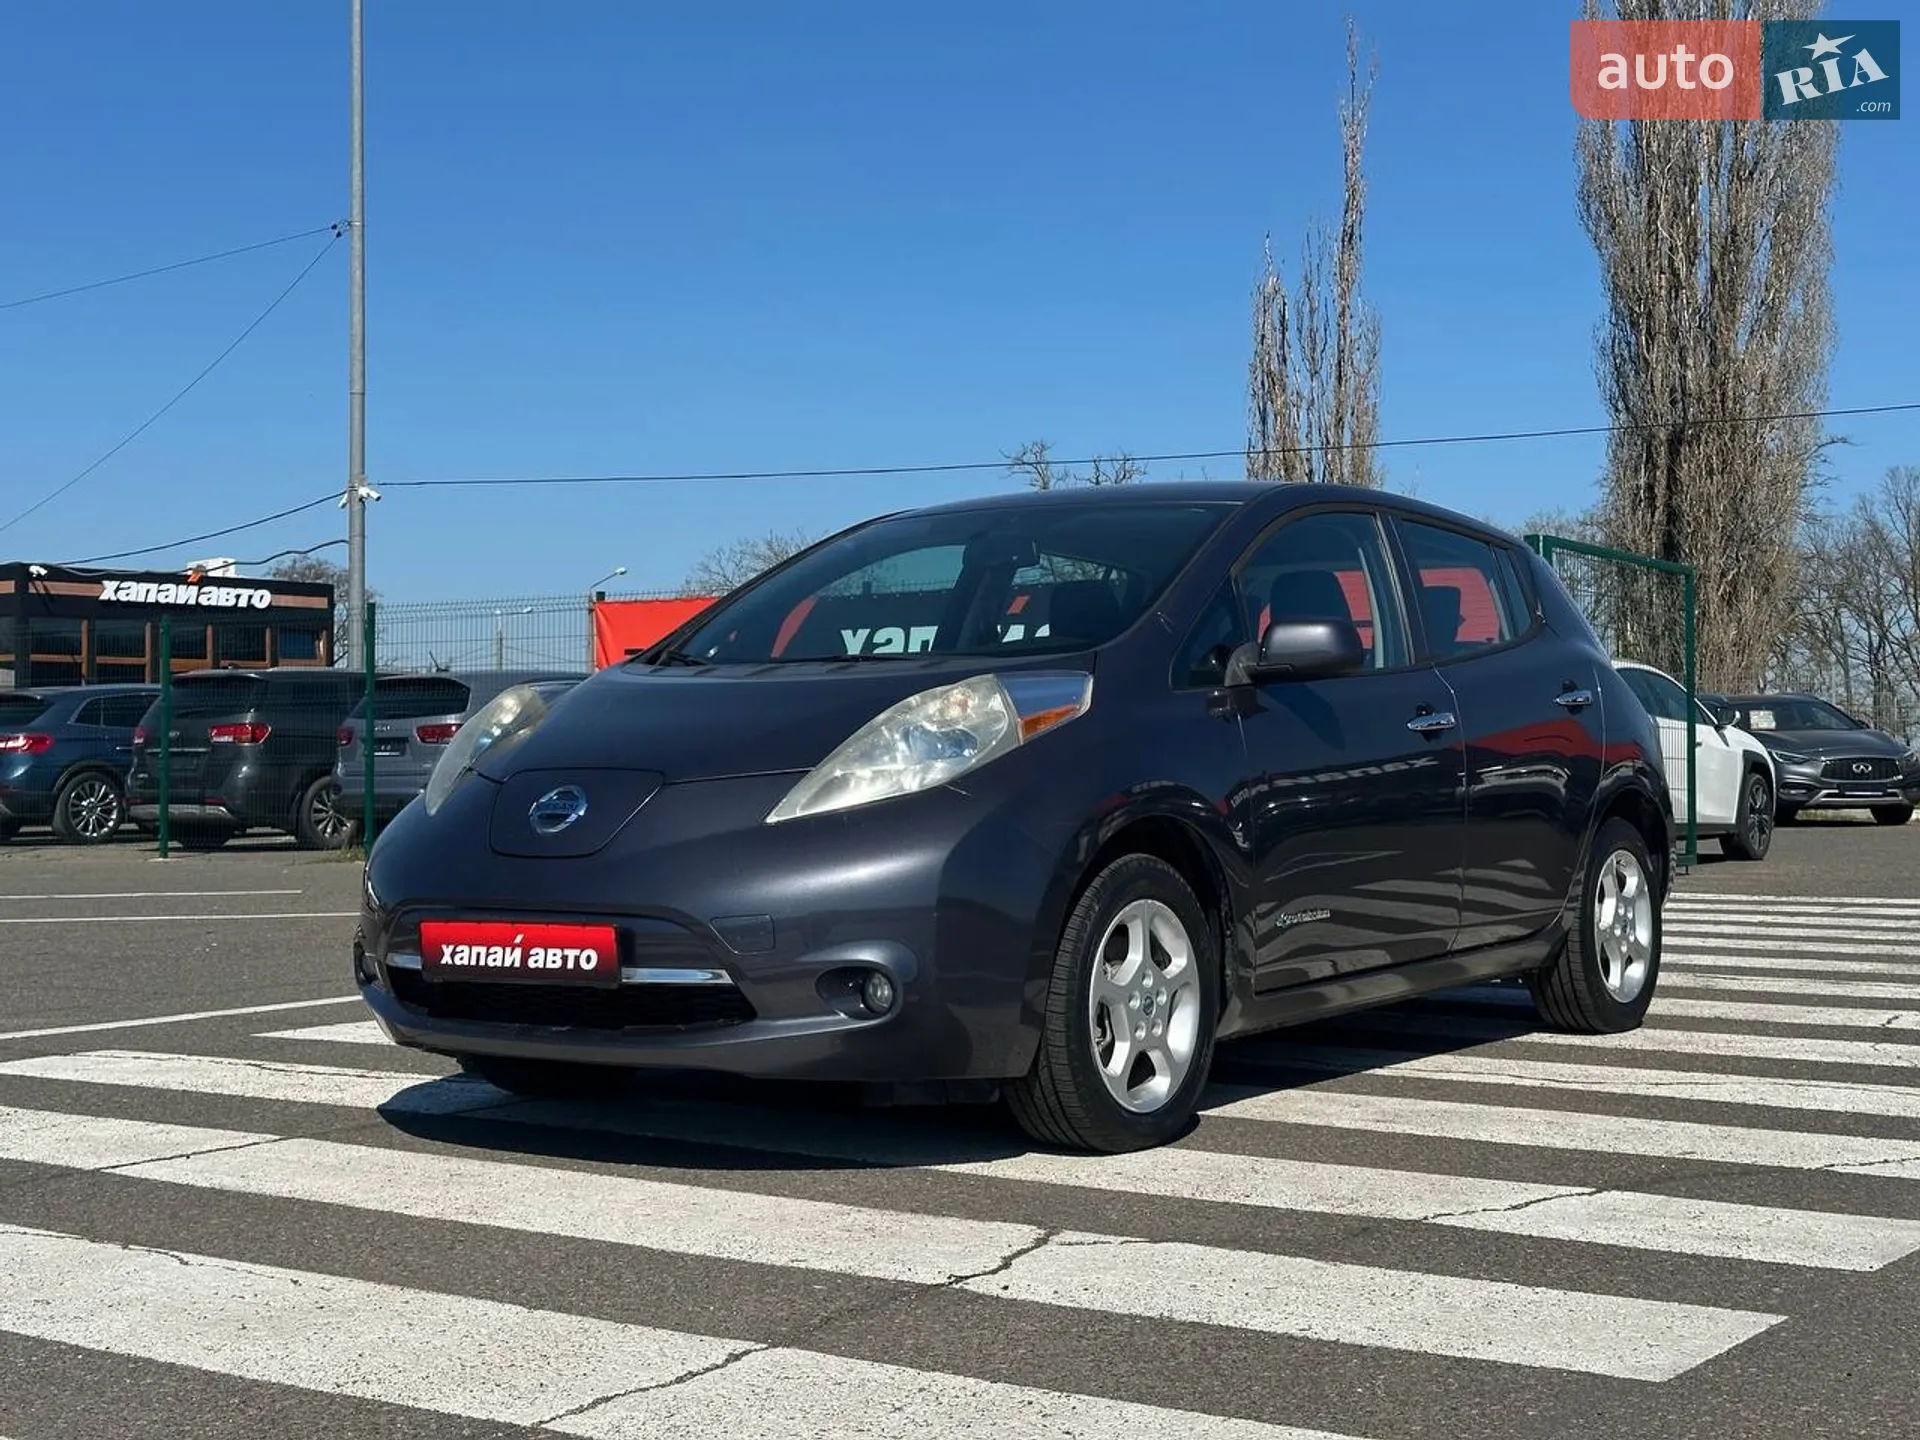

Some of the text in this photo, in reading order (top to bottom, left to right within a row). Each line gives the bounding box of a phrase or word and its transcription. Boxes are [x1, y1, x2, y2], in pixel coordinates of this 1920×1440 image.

[198, 585, 272, 609] авто
[440, 933, 598, 970] хапай авто
